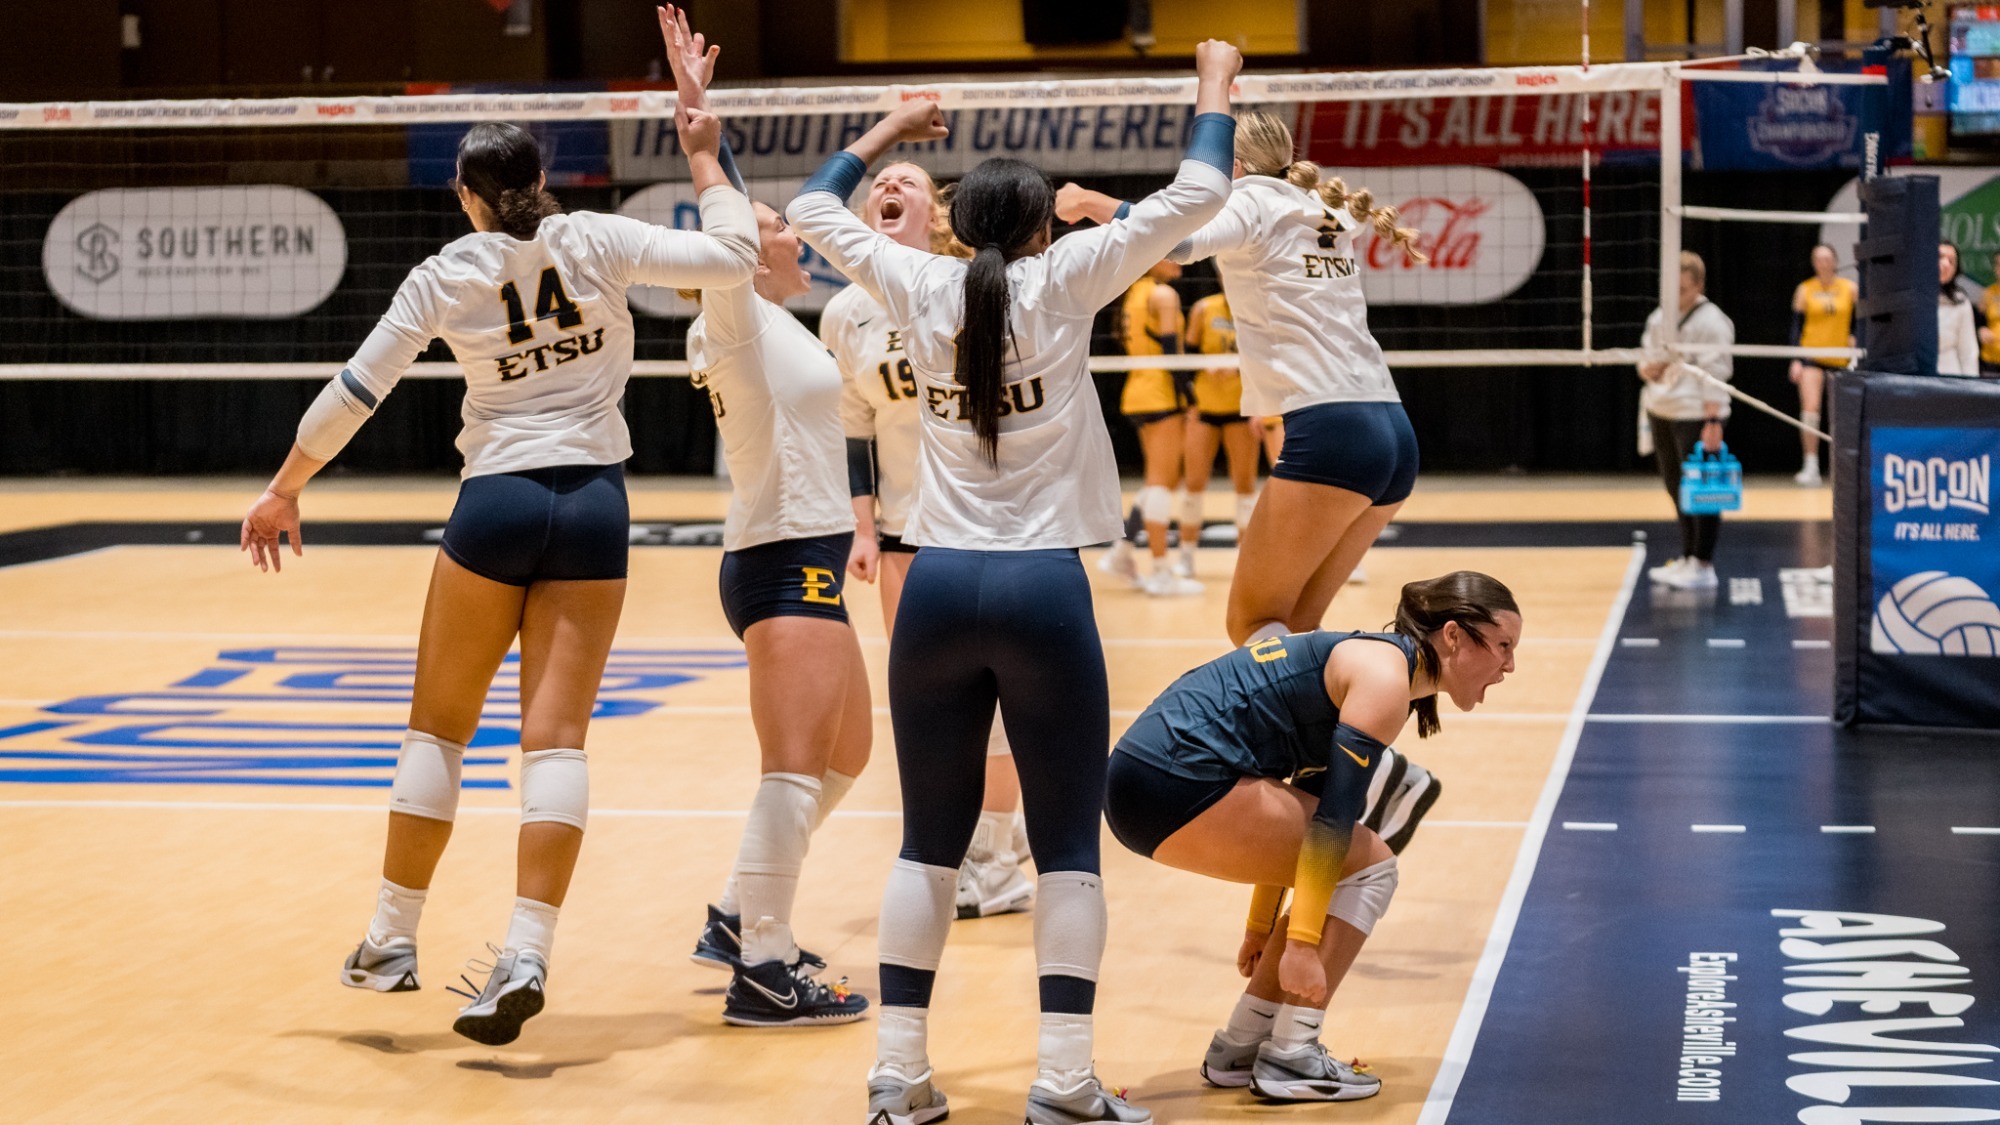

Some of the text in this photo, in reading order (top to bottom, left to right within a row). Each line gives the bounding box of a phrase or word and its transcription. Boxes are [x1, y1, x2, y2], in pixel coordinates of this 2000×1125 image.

[1437, 95, 1524, 146] ALL
[1531, 91, 1663, 144] HERE
[136, 224, 316, 259] SOUTHERN
[499, 263, 584, 346] 14
[494, 327, 605, 382] ETSU
[879, 357, 918, 402] 19
[1894, 521, 1920, 541] IT'S
[1920, 521, 1943, 541] ALL
[801, 567, 840, 606] E
[1677, 952, 1738, 1101] ExploreAsheville.com
